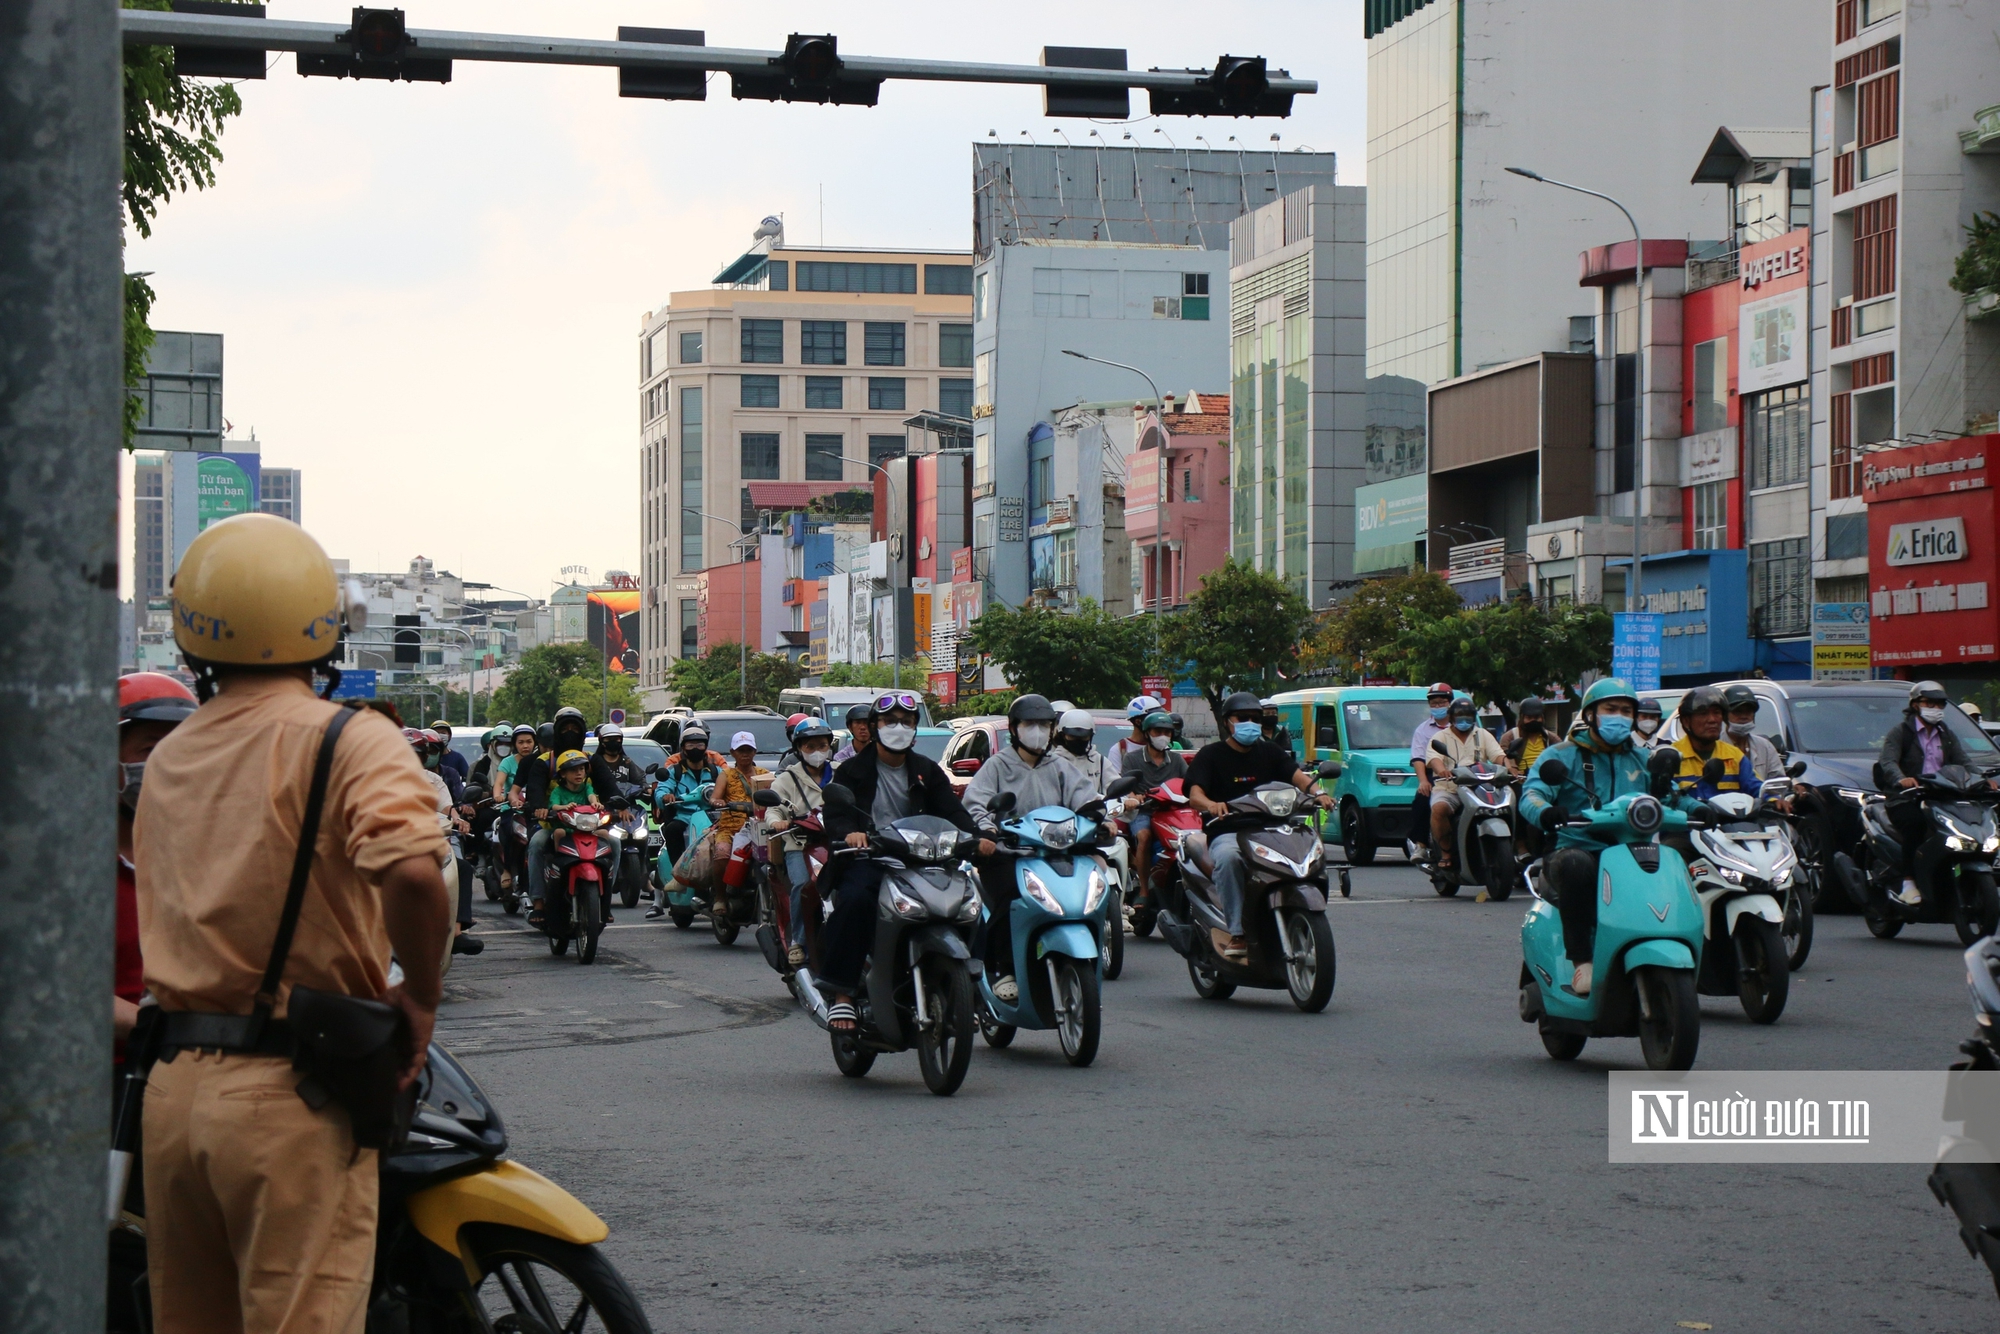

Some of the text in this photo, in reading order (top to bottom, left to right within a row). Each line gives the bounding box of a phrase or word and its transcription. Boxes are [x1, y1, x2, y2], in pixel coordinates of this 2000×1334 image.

[1742, 246, 1802, 287] HÄFELE
[200, 474, 234, 484] Từ fan
[224, 486, 244, 497] bạn
[1001, 497, 1023, 506] ANH
[1360, 504, 1379, 531] BIDV
[1005, 533, 1019, 541] EM
[1912, 526, 1957, 559] Erica
[560, 565, 588, 575] HOTEL
[1647, 588, 1680, 614] THÀNH
[1680, 583, 1707, 612] PHÁT
[1622, 624, 1656, 632] 15/5/2026
[1614, 643, 1660, 660] CỘNG HÒA
[1816, 649, 1868, 660] NHẬT PHÚC
